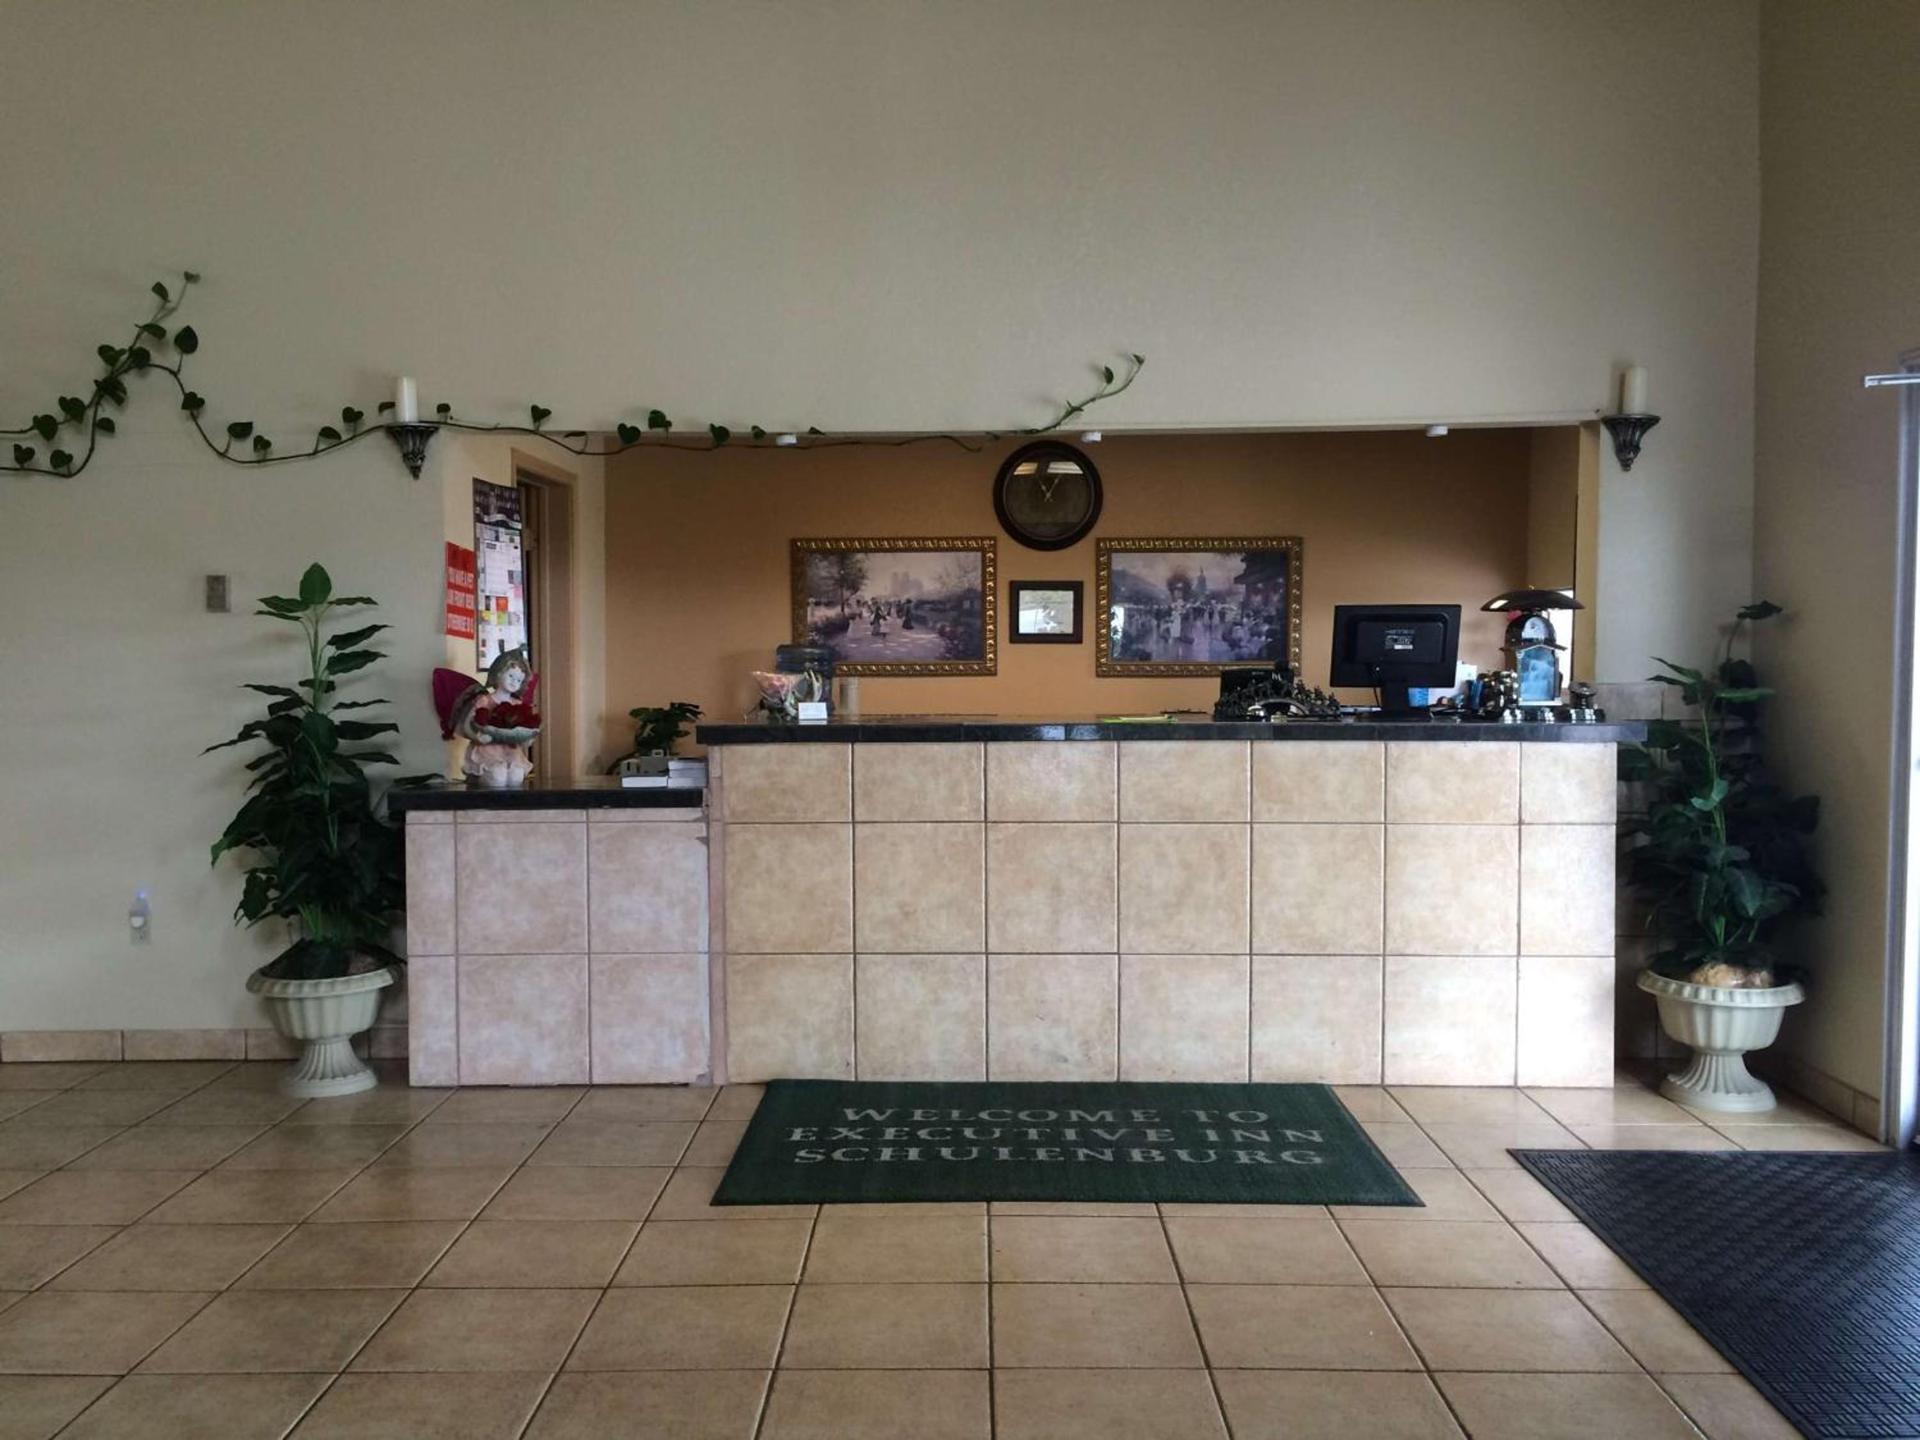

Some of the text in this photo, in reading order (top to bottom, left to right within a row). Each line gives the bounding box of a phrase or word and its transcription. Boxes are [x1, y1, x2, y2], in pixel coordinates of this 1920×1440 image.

[843, 1108, 1270, 1123] WELCOME TO
[789, 1127, 1325, 1143] EXECUTIVE INN
[794, 1147, 1325, 1164] SCHULENBURG
